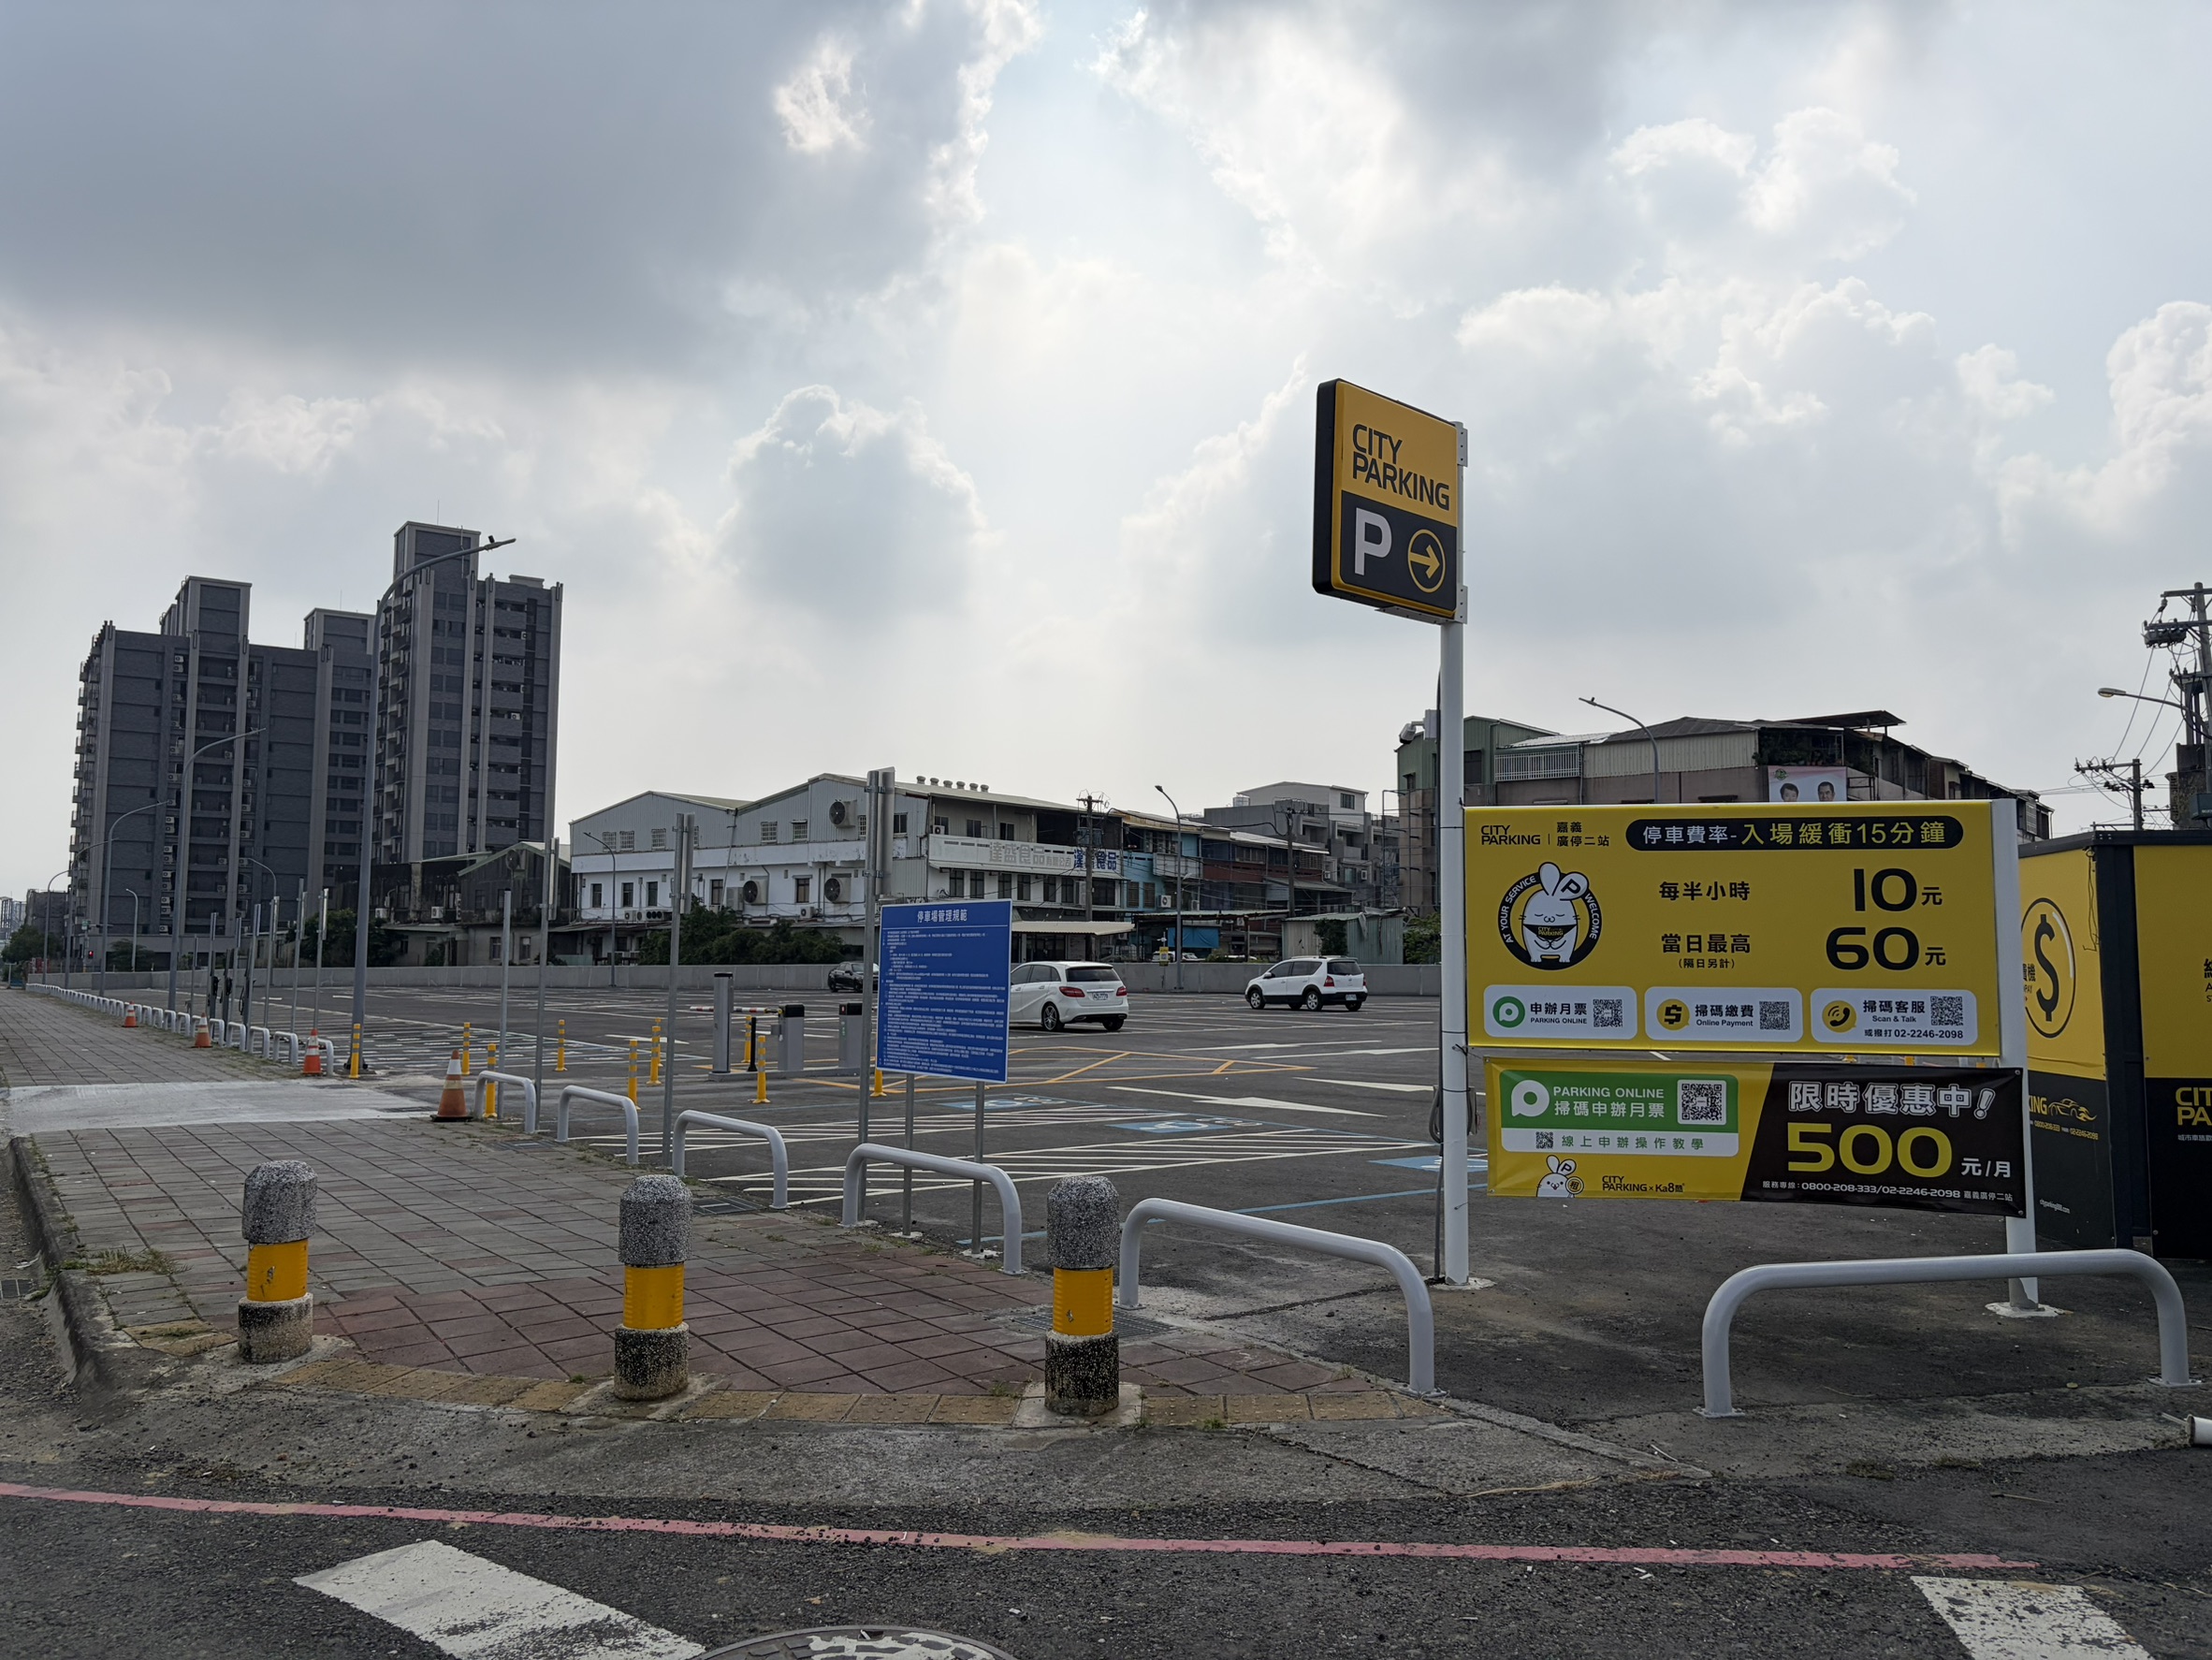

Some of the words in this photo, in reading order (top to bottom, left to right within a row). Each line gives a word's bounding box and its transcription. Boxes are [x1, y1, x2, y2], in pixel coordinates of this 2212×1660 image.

[1352, 424, 1403, 465] CITY
[1352, 450, 1449, 511] PARKING
[1354, 507, 1392, 576] P
[1481, 825, 1511, 835] CITY
[1557, 822, 1582, 833] 嘉義
[1481, 835, 1541, 845] PARKING
[1557, 835, 1609, 847] 廣停二站
[1506, 875, 1536, 904] SERVICE
[1561, 879, 1580, 896] P
[1659, 881, 1751, 901] 每半小時
[917, 909, 968, 924] 停車場管理規範
[1500, 906, 1510, 930] YOUR
[1584, 893, 1600, 939] WELCOME
[1503, 933, 1514, 944] AT
[1661, 933, 1751, 954] 當日最高
[1530, 1002, 1588, 1015] 申辦月票
[1695, 1004, 1754, 1018] 掃碼繳費
[1863, 1000, 1926, 1013] 掃碼客服
[1721, 1019, 1754, 1028] Payment
[1894, 1029, 1963, 1039] 02-2246-2098
[1553, 1086, 1610, 1098] PARKING
[1615, 1087, 1665, 1099] ONLINE
[1554, 1100, 1666, 1118] 掃碼申辦月票
[1561, 1135, 1705, 1150] 線上申辦操作教學
[1787, 1122, 1953, 1177] 500
[1602, 1183, 1648, 1192] PARKING
